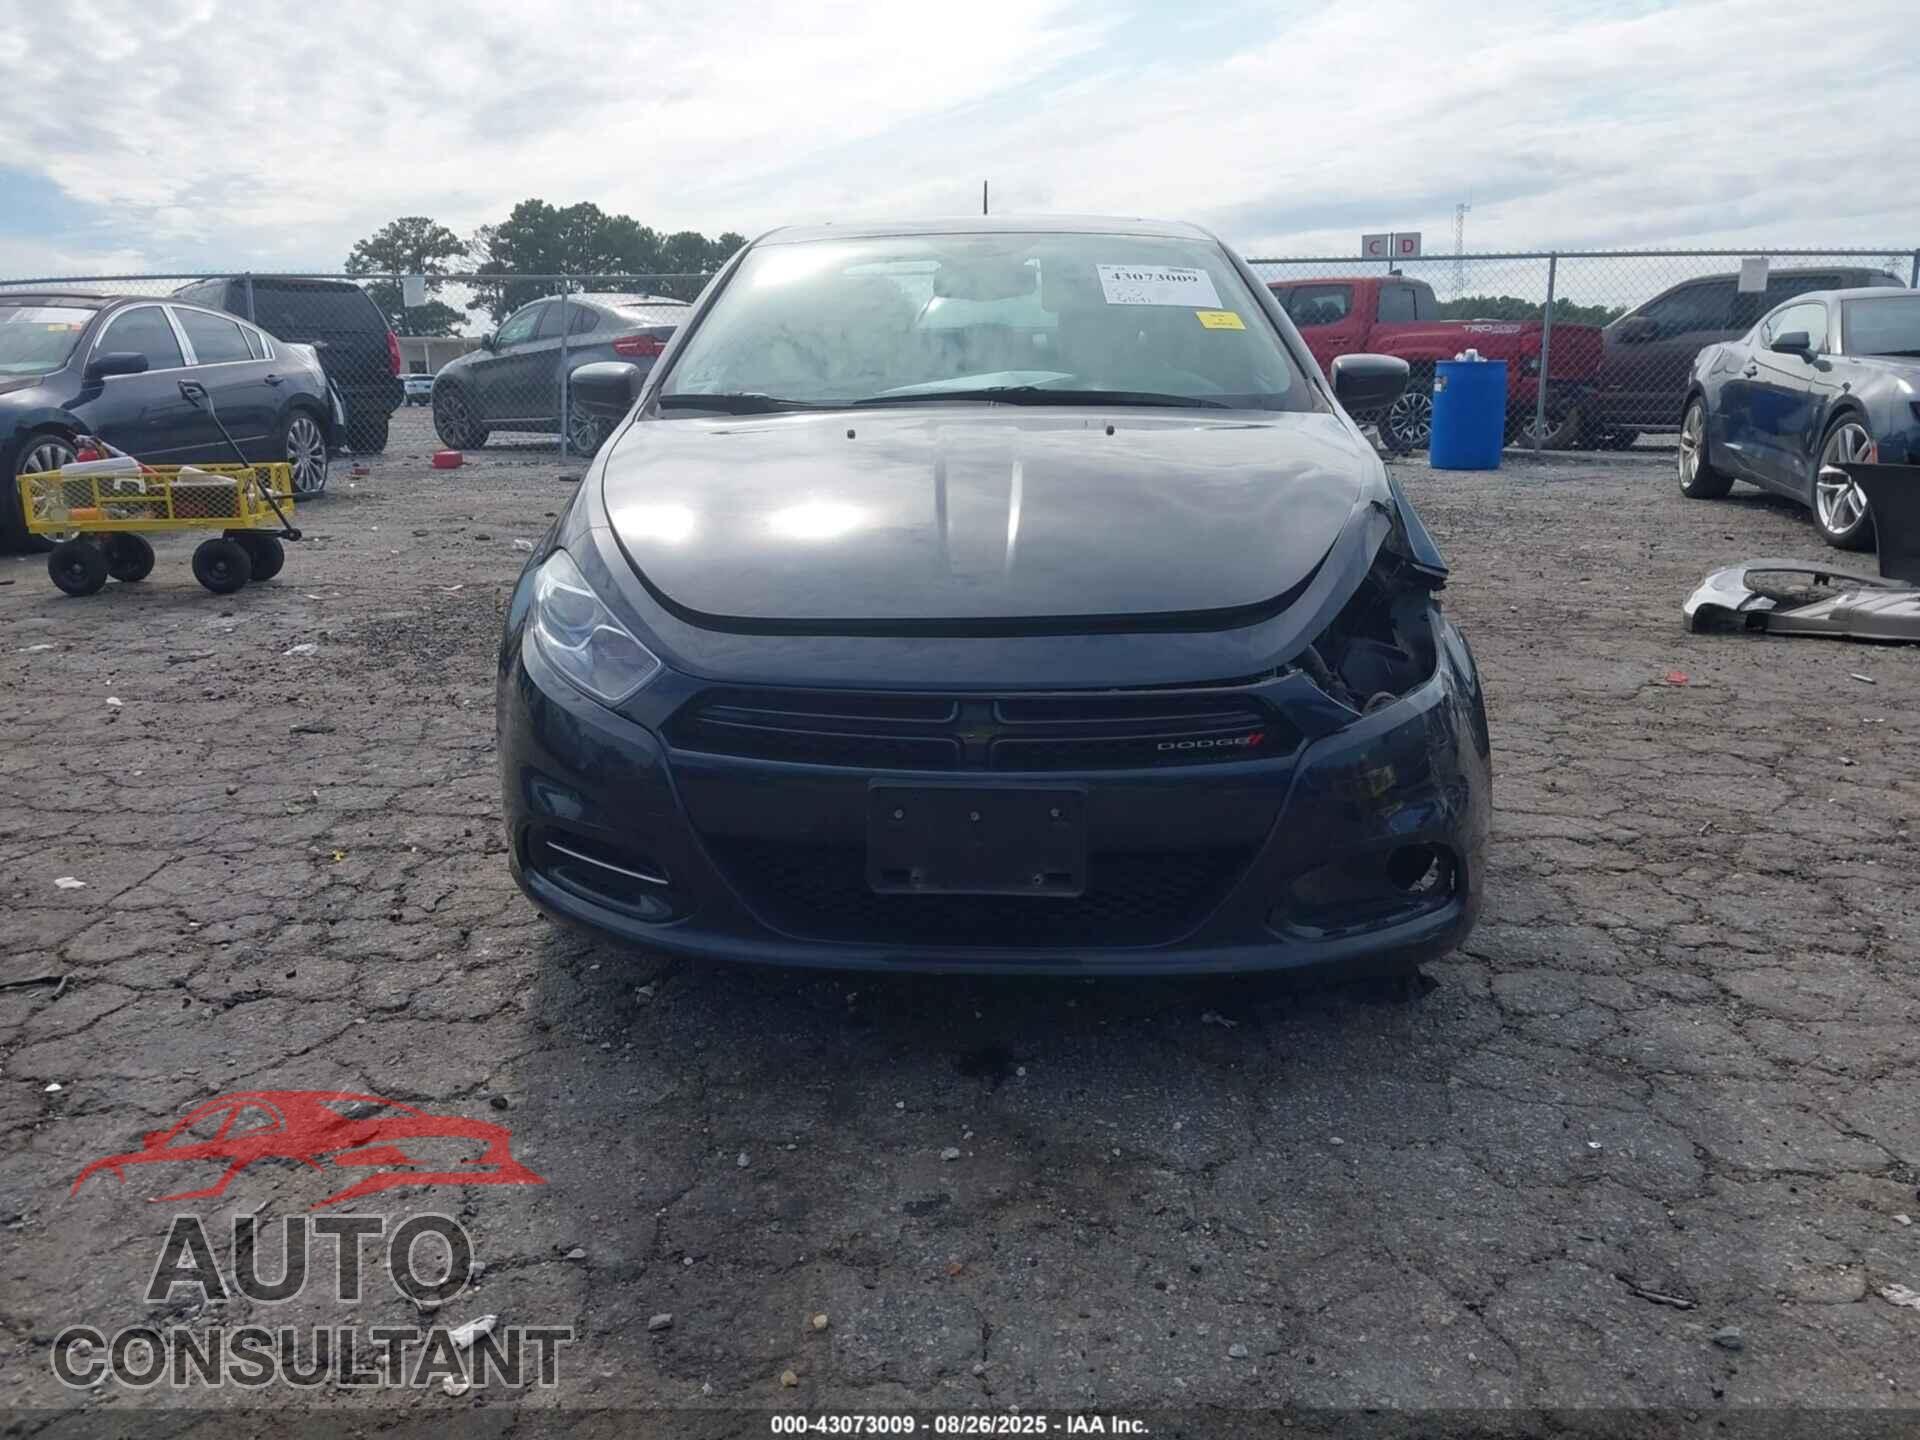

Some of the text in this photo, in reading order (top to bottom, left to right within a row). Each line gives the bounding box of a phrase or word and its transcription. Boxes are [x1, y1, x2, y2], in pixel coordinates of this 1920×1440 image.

[1369, 240, 1381, 255] C
[1402, 239, 1414, 253] D
[1111, 271, 1199, 283] 43073009
[1157, 737, 1249, 751] DODGE
